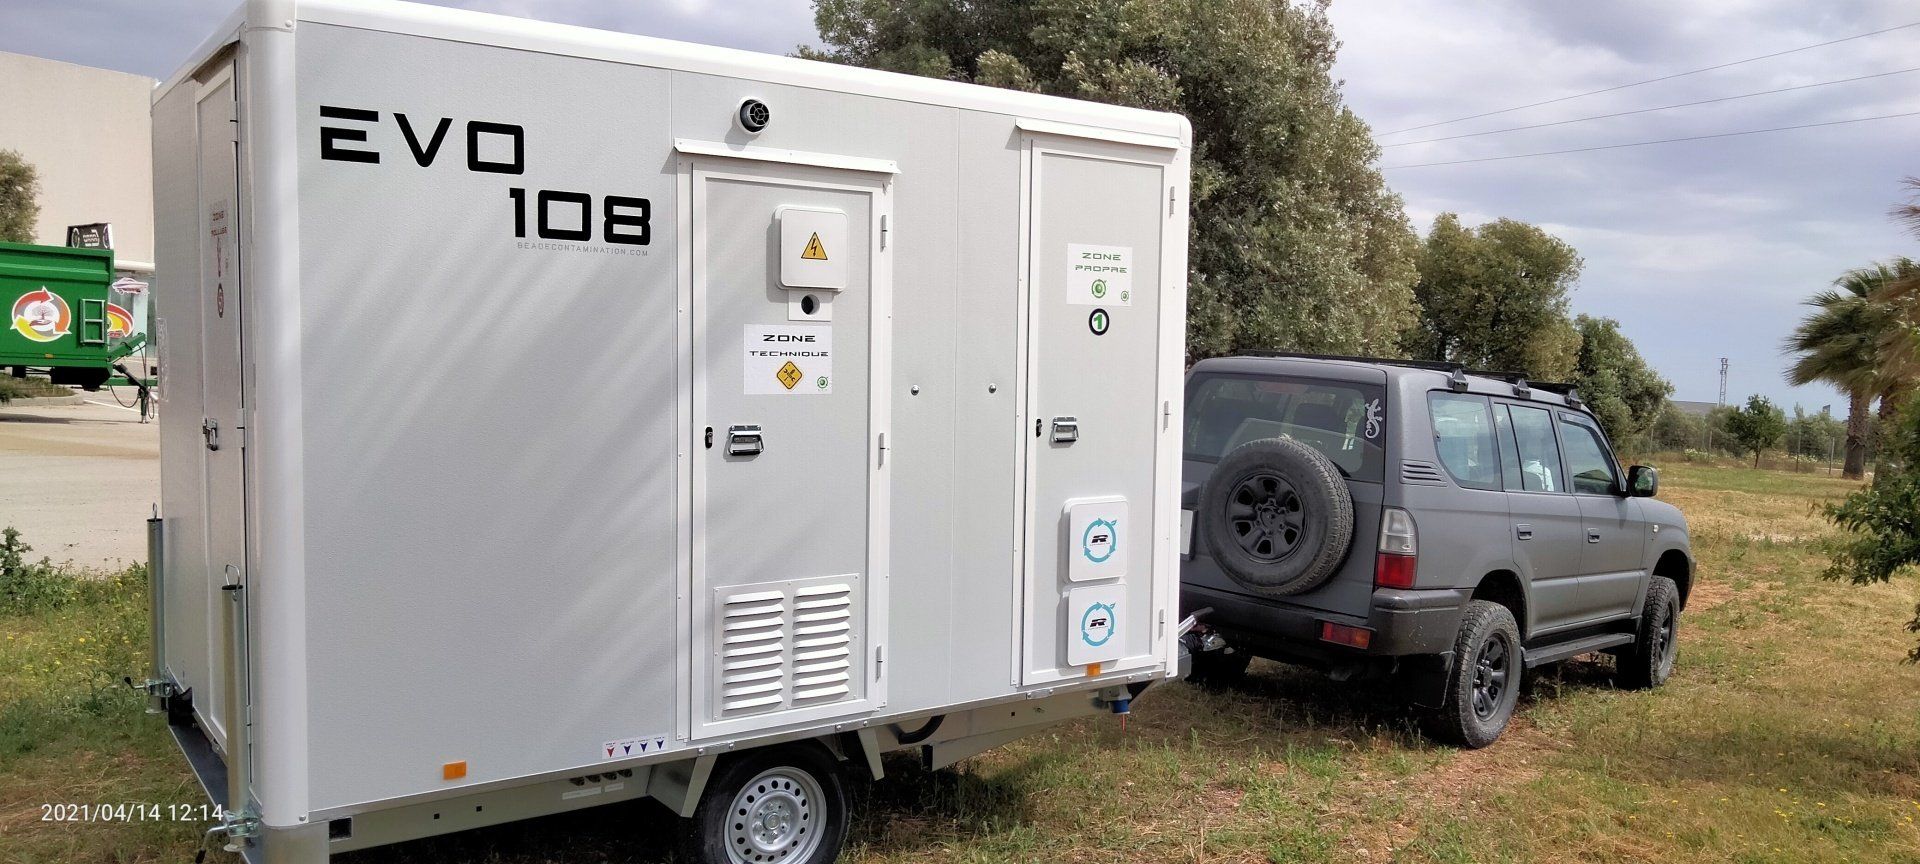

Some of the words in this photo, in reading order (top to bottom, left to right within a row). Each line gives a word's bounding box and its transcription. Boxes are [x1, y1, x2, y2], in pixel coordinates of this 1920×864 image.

[320, 105, 525, 175] EVO
[509, 187, 651, 246] 108
[1082, 252, 1122, 261] ZONE
[1075, 264, 1127, 273] PROPRE
[1093, 313, 1103, 330] 1
[763, 334, 816, 342] ZONE
